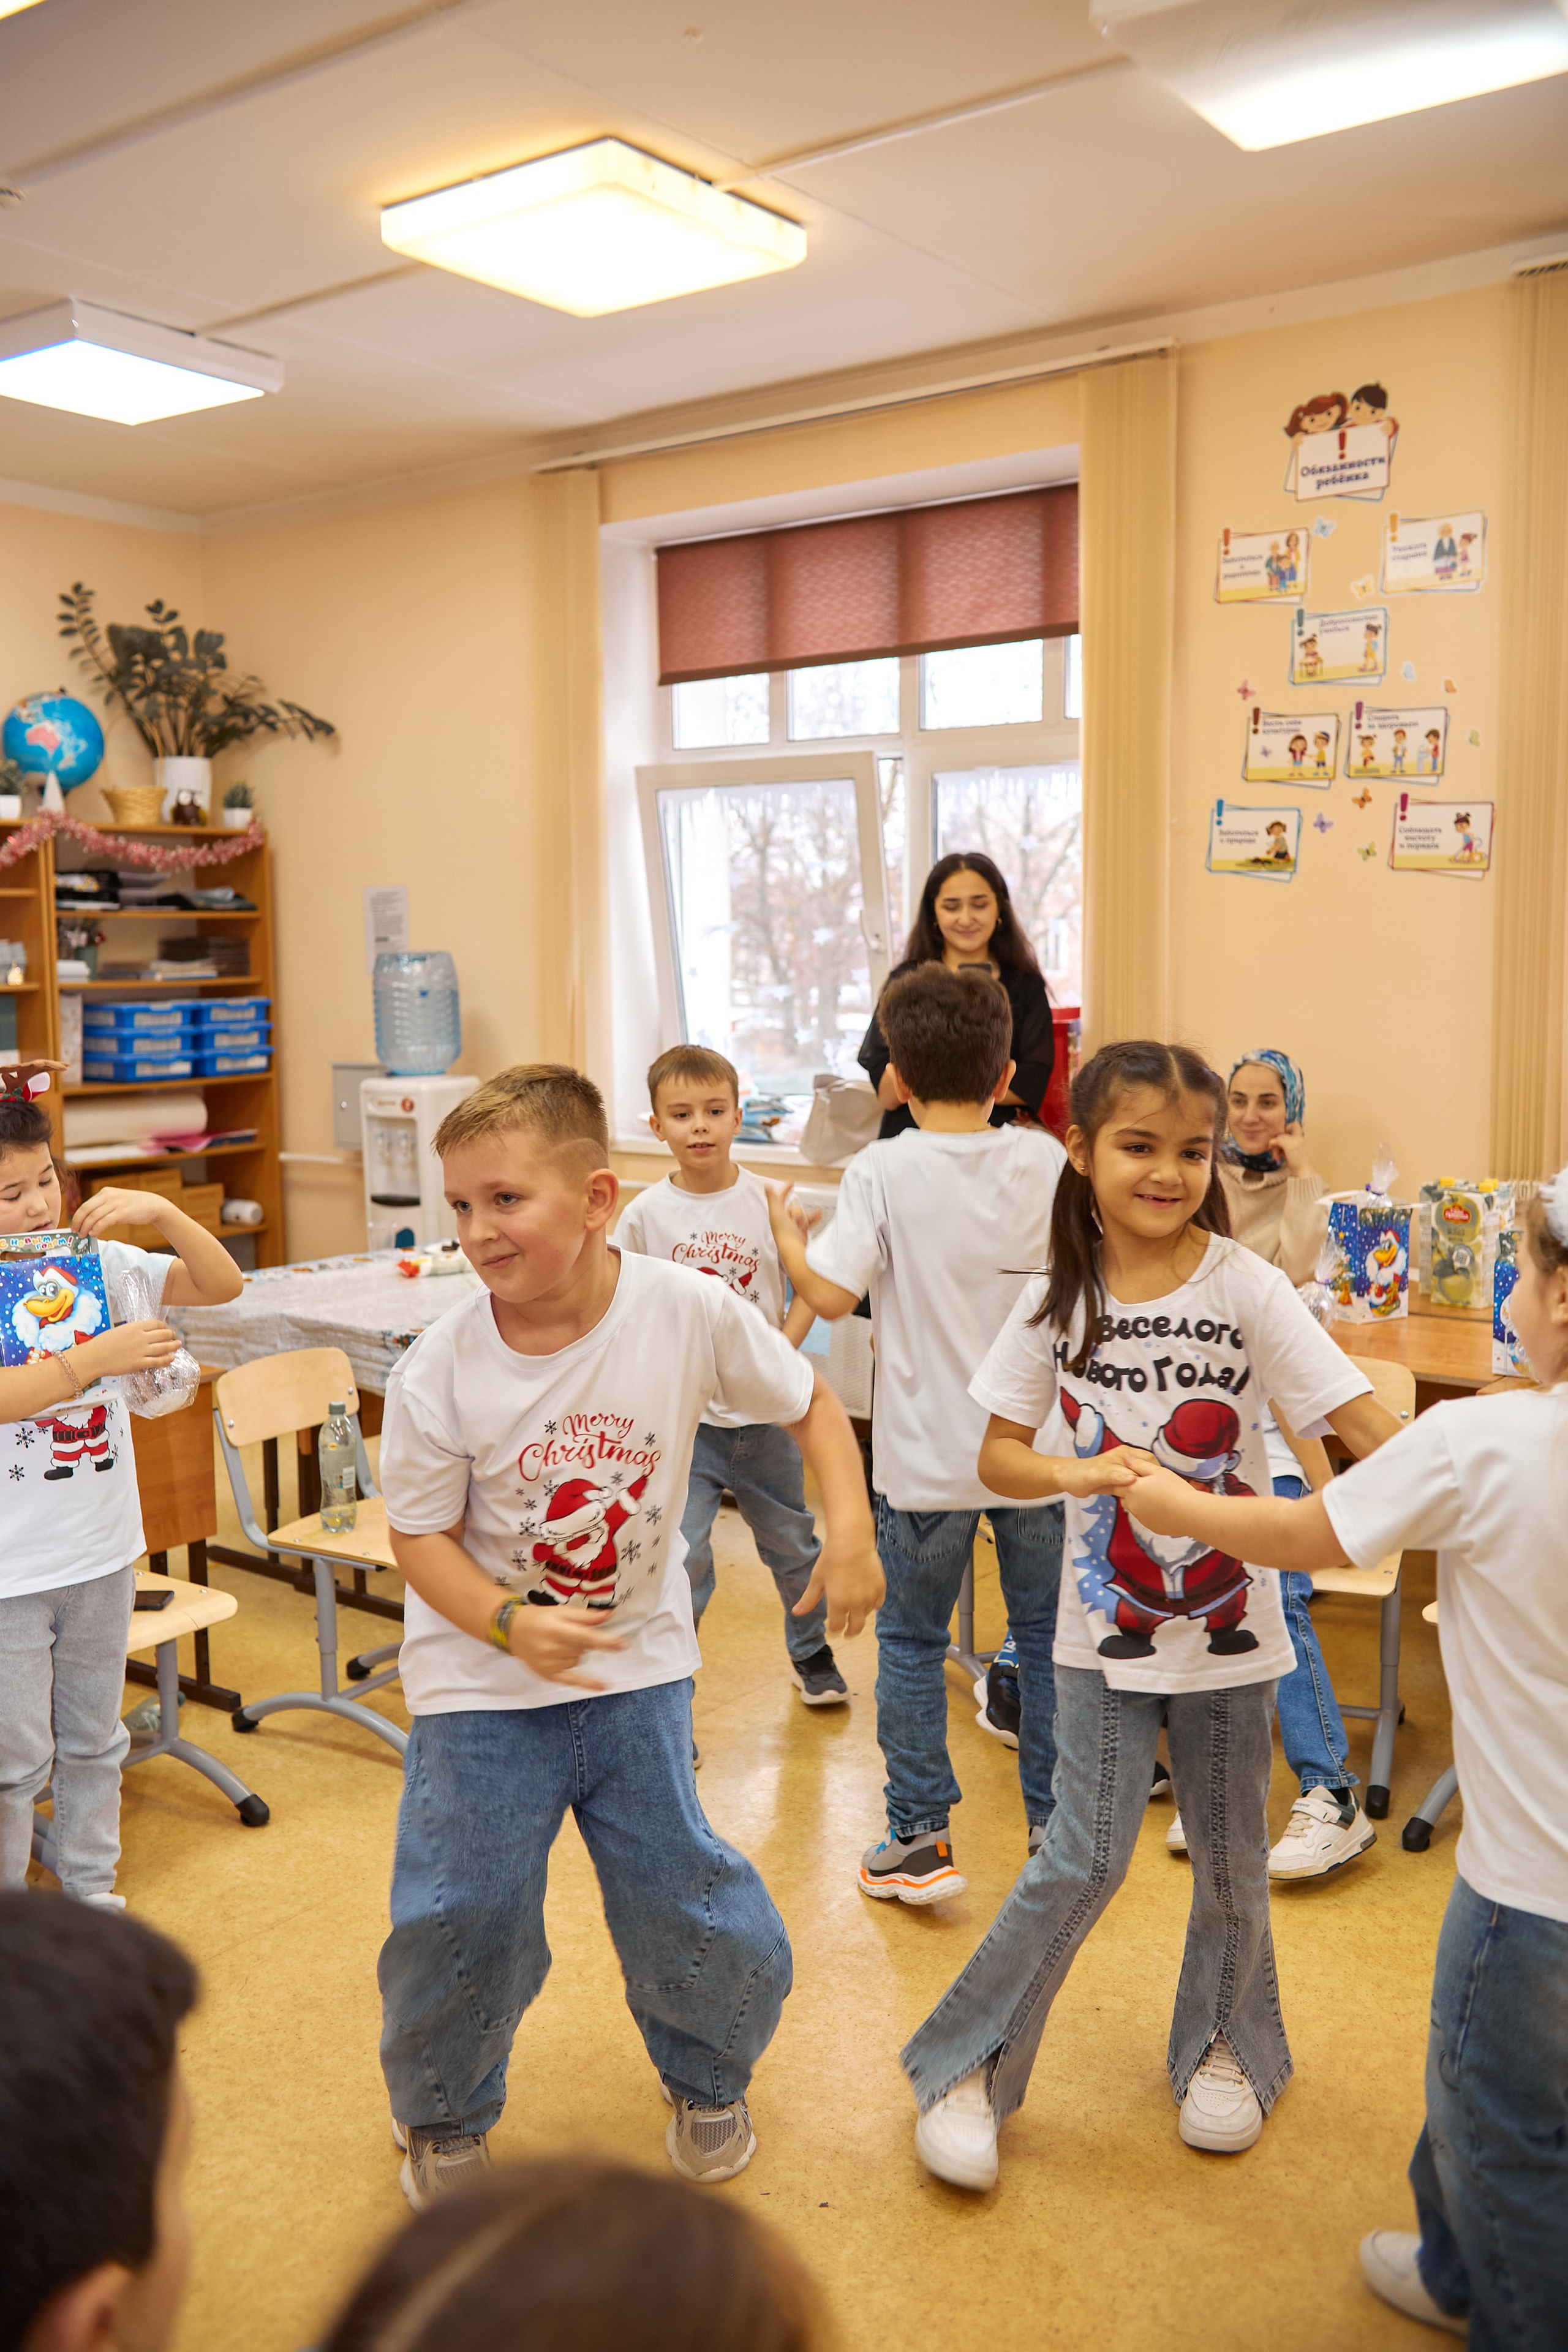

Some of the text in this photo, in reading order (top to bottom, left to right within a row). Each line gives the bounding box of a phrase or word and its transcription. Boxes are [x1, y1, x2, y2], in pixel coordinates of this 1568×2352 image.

[1300, 456, 1385, 477] Обязанности
[1316, 471, 1370, 490] ребёнка
[701, 1231, 747, 1249] Merry
[672, 1243, 761, 1273] Christmas
[562, 1413, 634, 1439] Merry
[519, 1431, 662, 1482] Christmas
